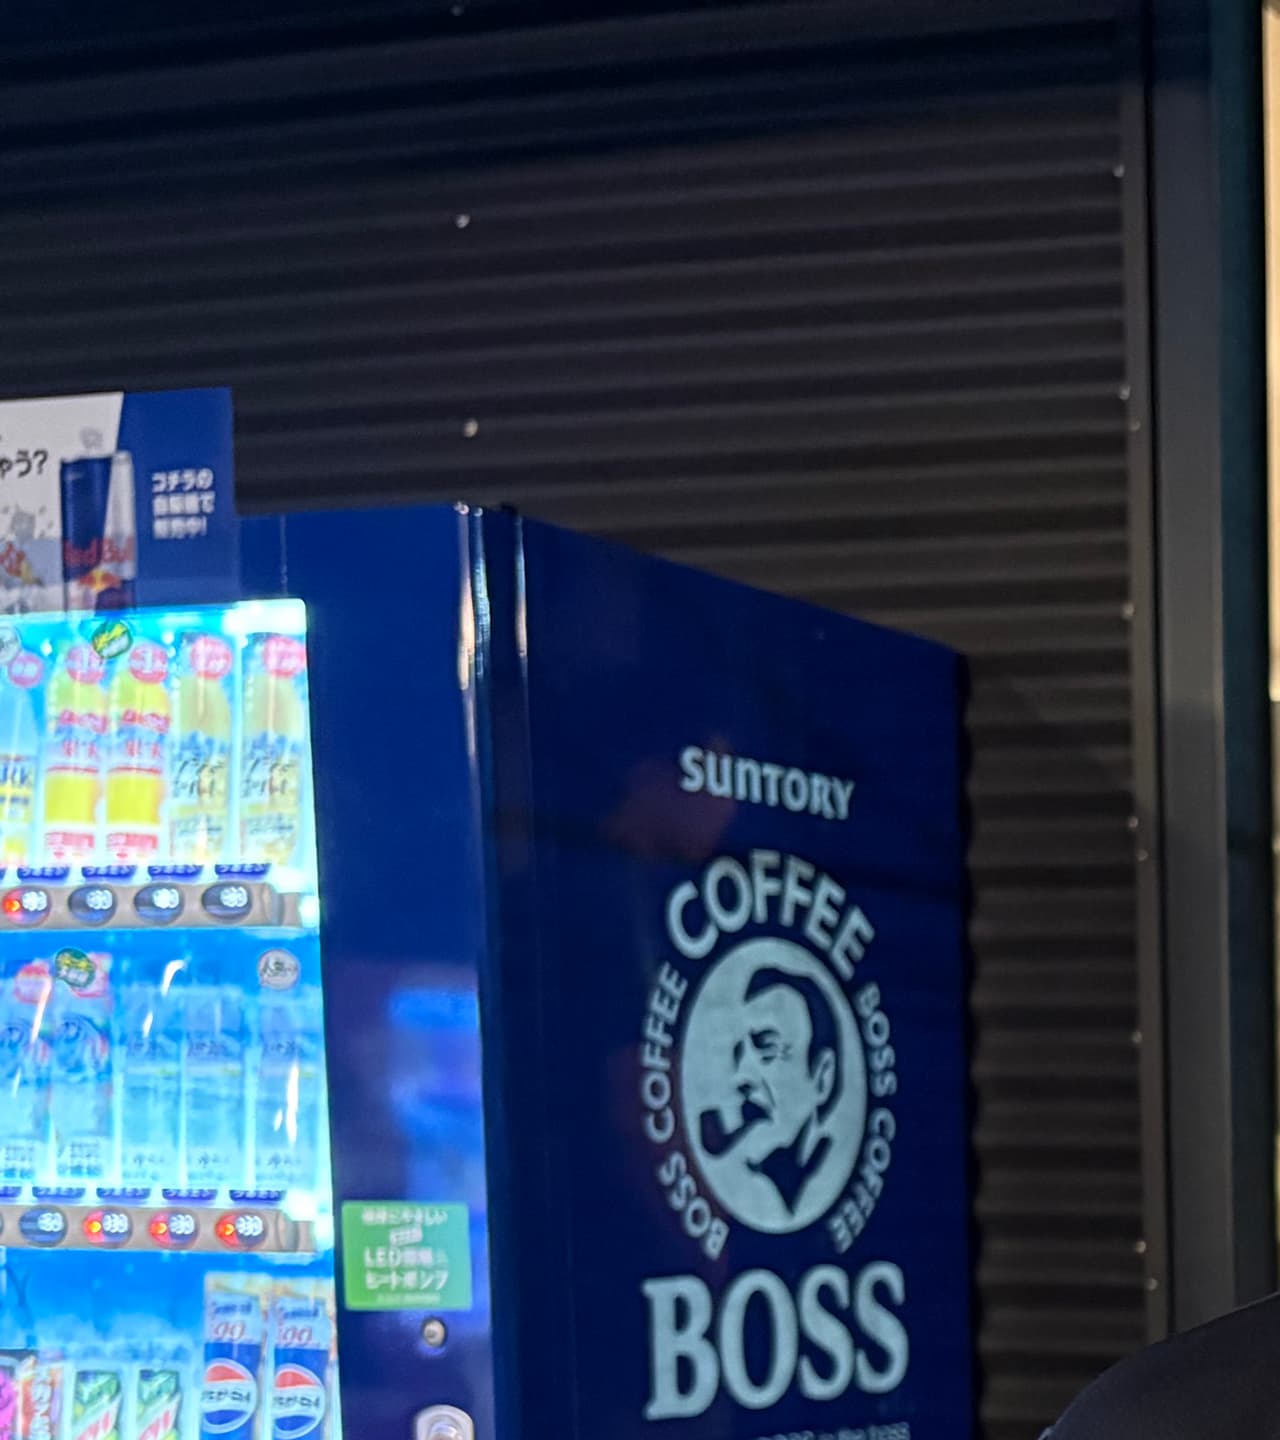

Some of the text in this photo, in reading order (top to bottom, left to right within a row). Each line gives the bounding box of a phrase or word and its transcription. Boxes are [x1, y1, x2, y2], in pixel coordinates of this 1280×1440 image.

[667, 848, 875, 982] COFFEE
[641, 961, 729, 1260] BOSS COFFEE
[828, 981, 897, 1254] BOSS COFFEE
[642, 1261, 909, 1421] BOSS
